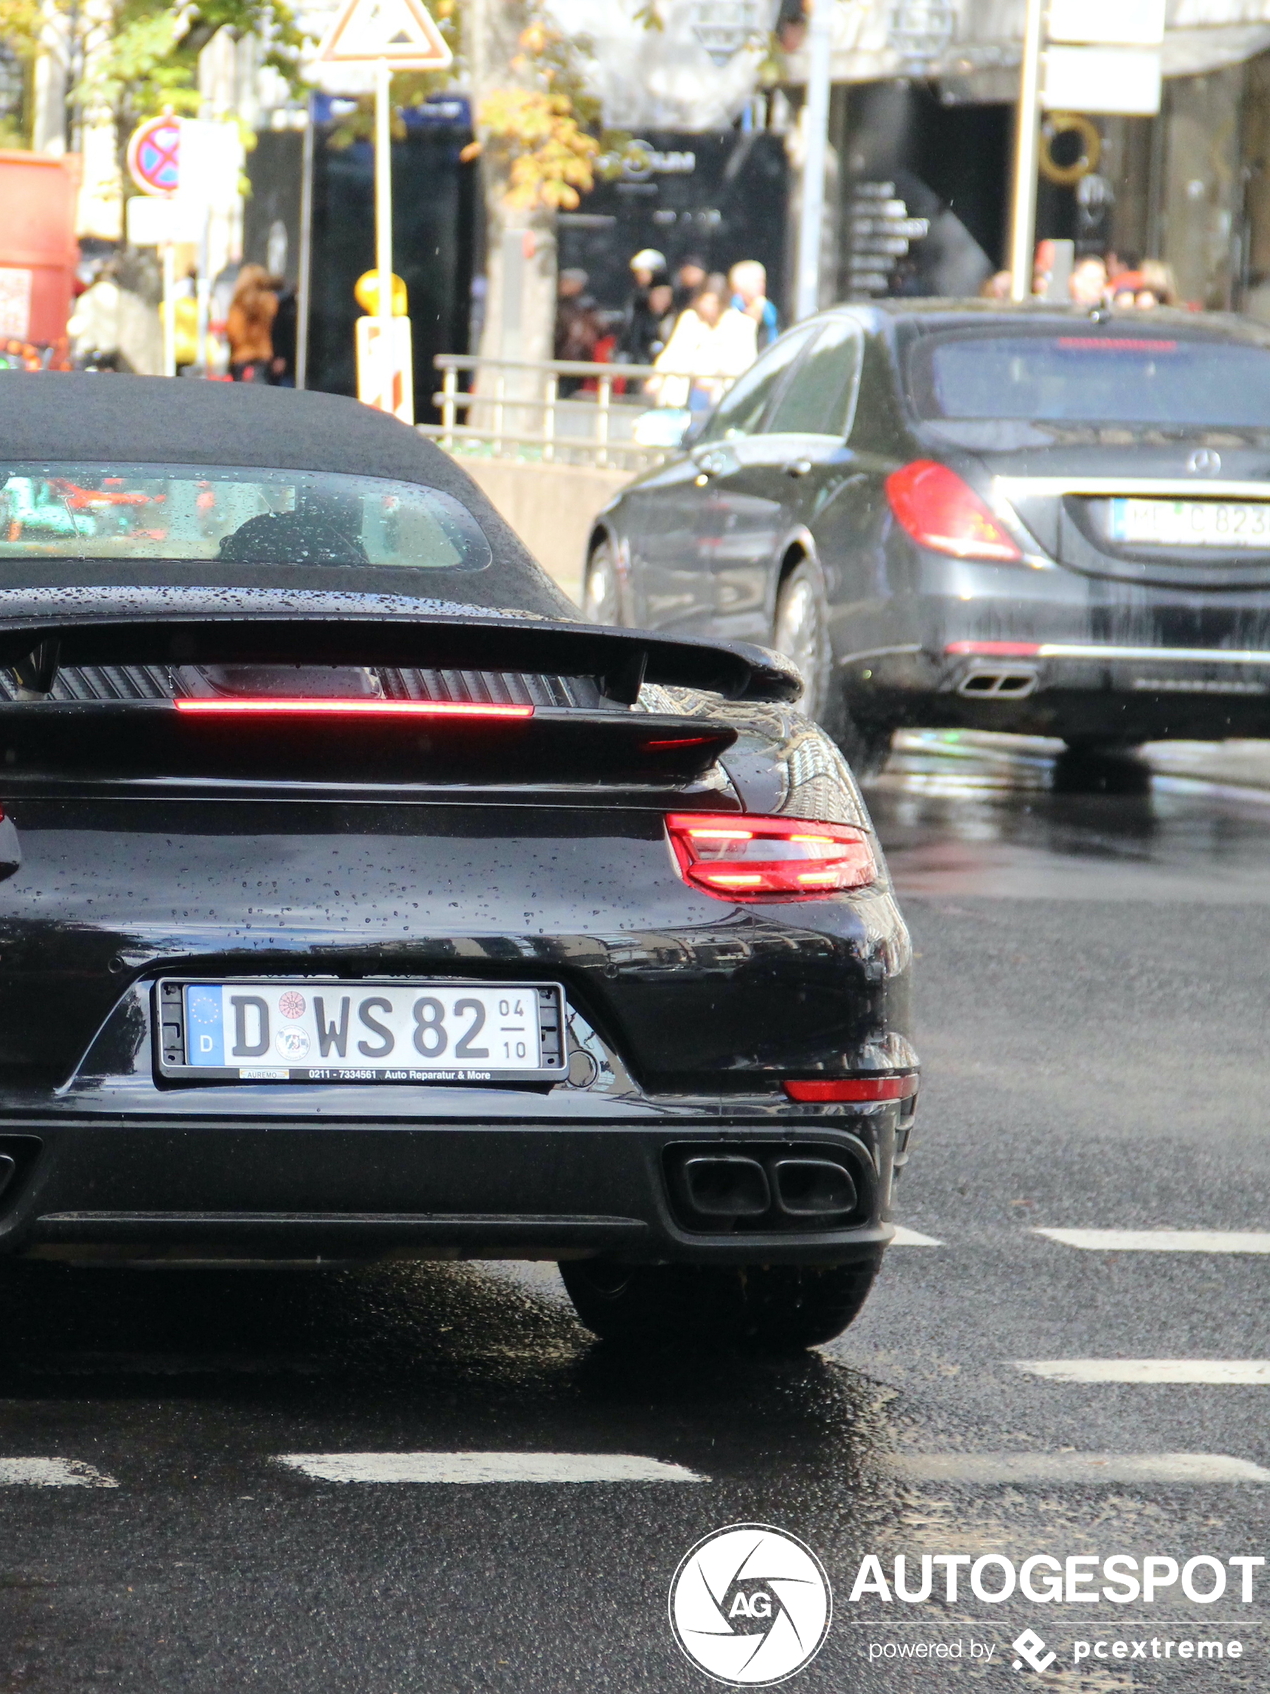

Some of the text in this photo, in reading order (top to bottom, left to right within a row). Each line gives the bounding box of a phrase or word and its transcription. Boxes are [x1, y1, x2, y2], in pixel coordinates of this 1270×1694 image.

[499, 999, 524, 1017] 04
[230, 995, 270, 1057] D
[313, 995, 395, 1059] WS
[413, 997, 490, 1059] 82
[200, 1035, 213, 1052] D
[504, 1041, 526, 1059] 10
[309, 1070, 330, 1079] 0211
[339, 1070, 376, 1079] 7334561
[385, 1070, 407, 1080] Auto
[409, 1070, 456, 1082] Reparatur
[458, 1071, 465, 1080] &
[467, 1071, 490, 1081] More
